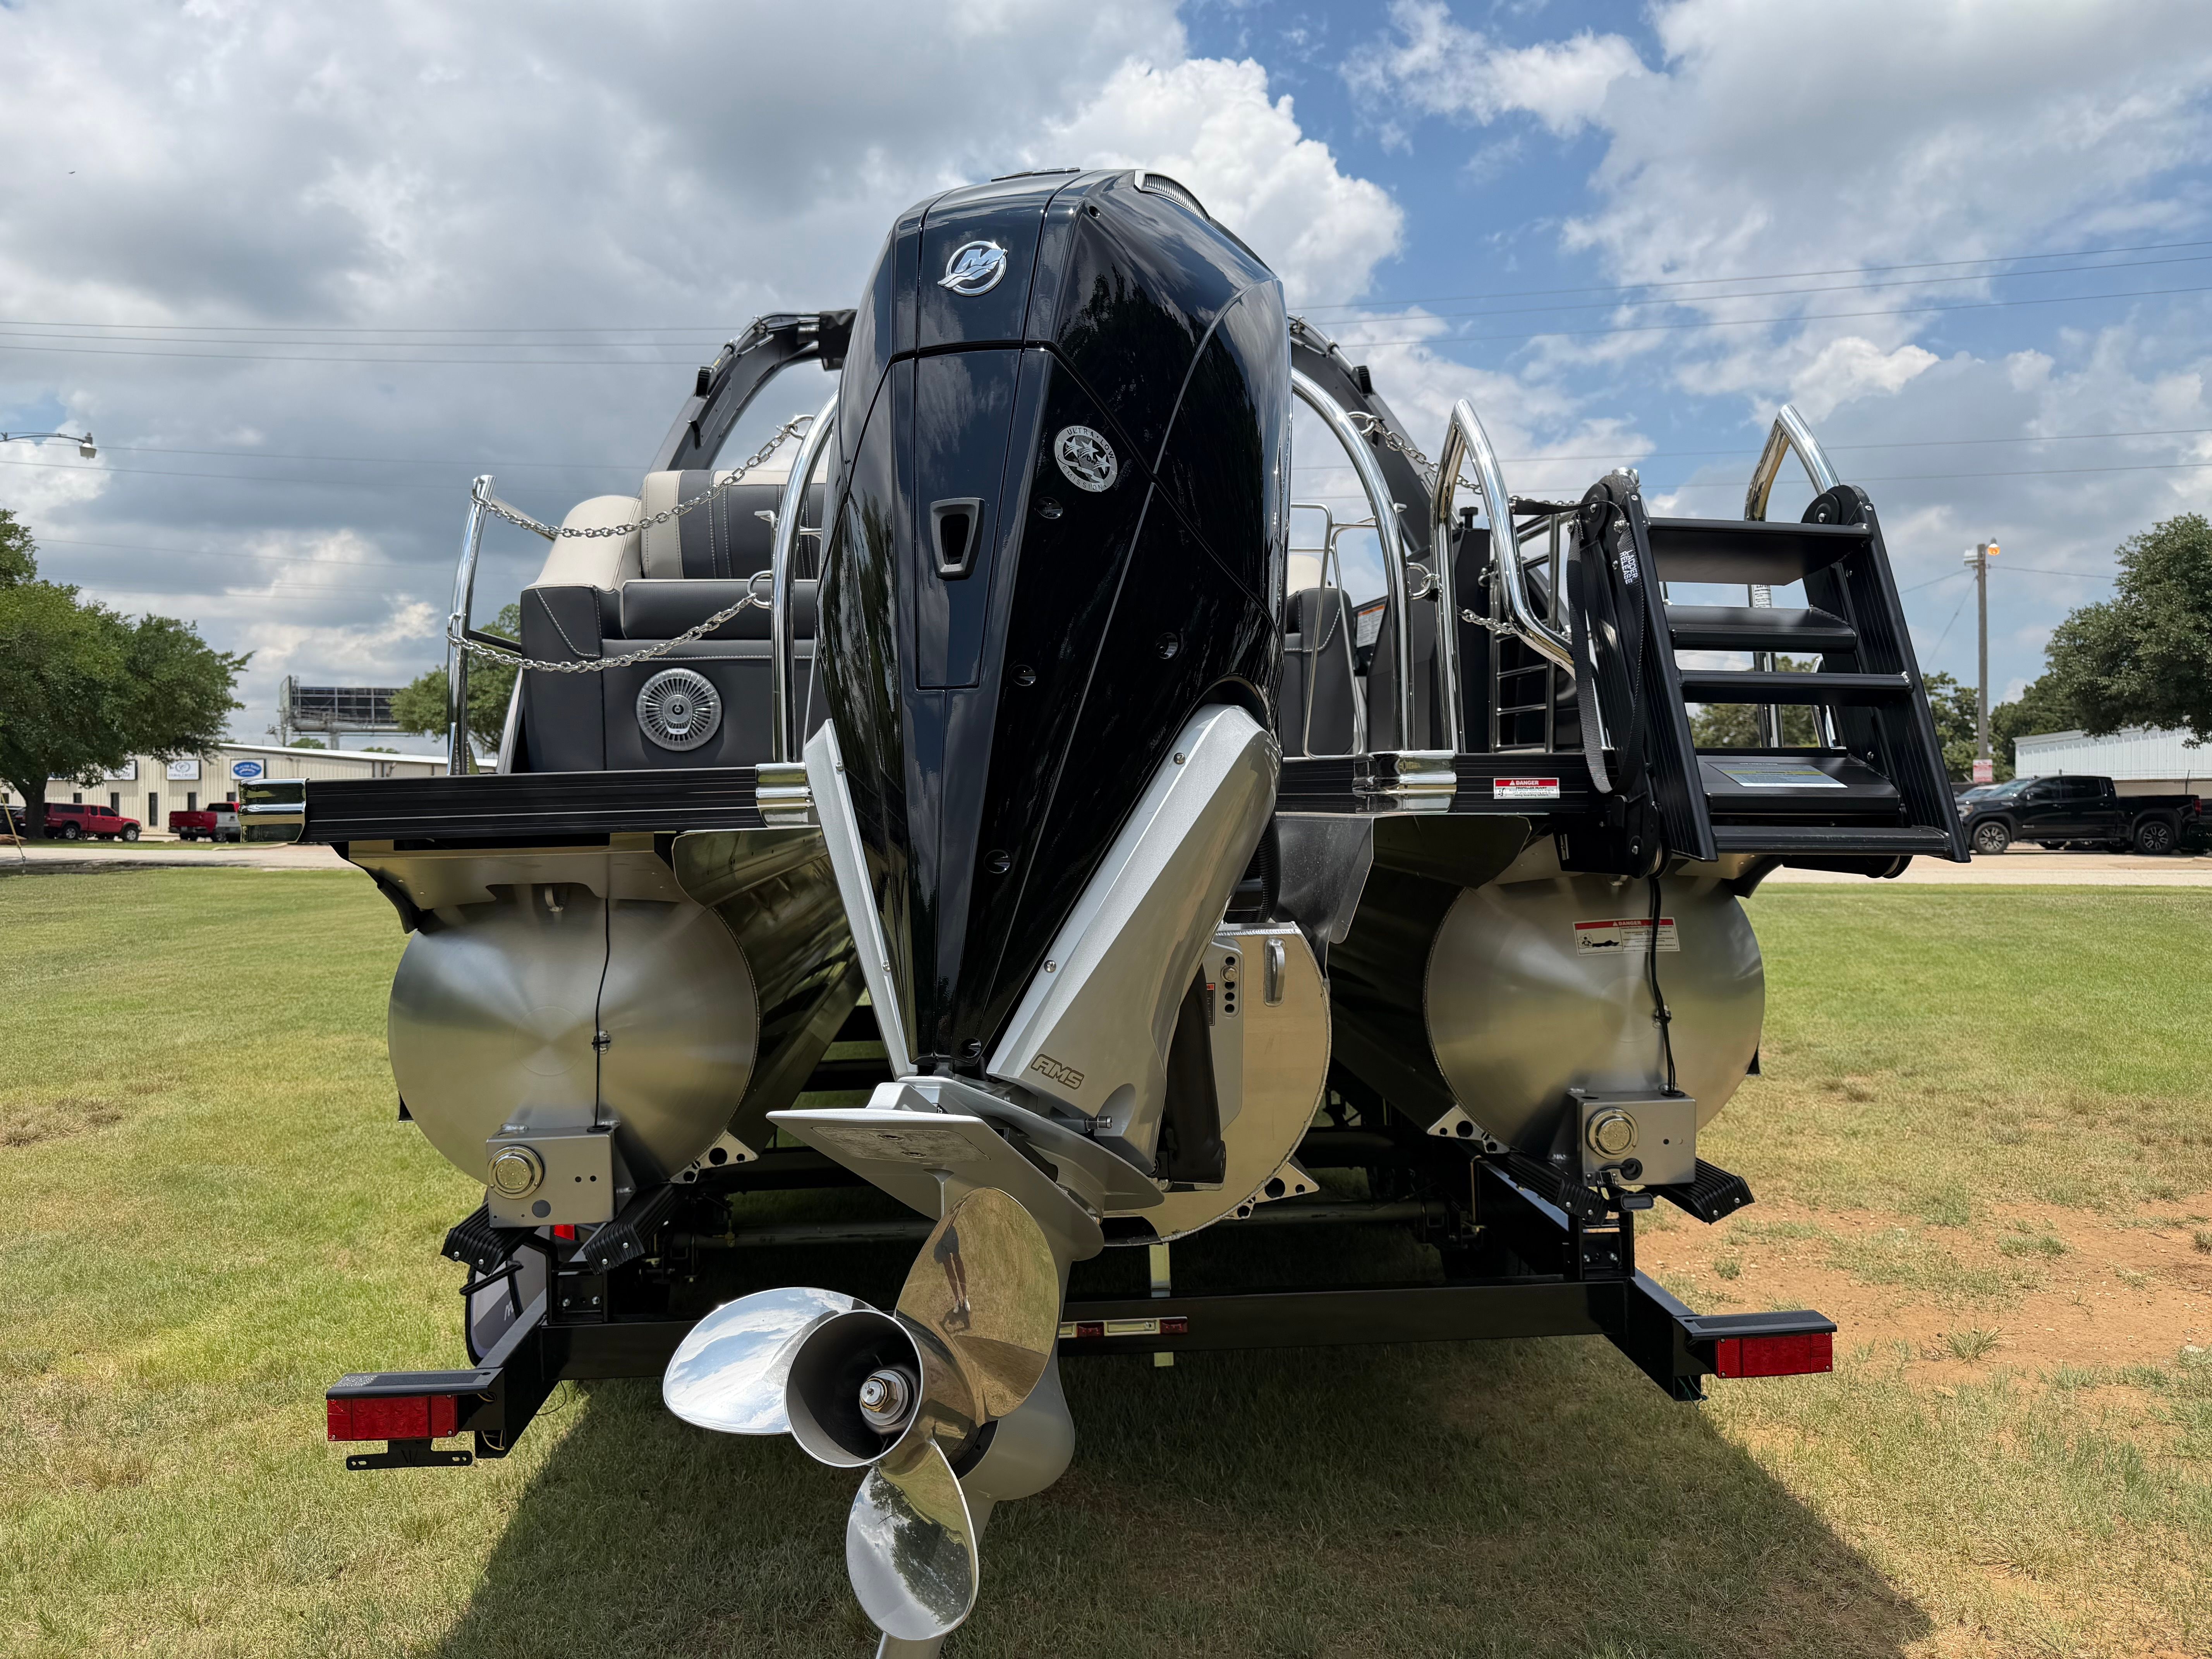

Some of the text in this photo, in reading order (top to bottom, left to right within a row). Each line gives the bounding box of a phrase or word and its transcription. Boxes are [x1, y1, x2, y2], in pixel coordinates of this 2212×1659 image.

[1062, 465, 1103, 490] EMISSION
[1620, 551, 1633, 584] RELEASE
[1626, 550, 1638, 579] LADDER
[1031, 1054, 1084, 1090] AMS
